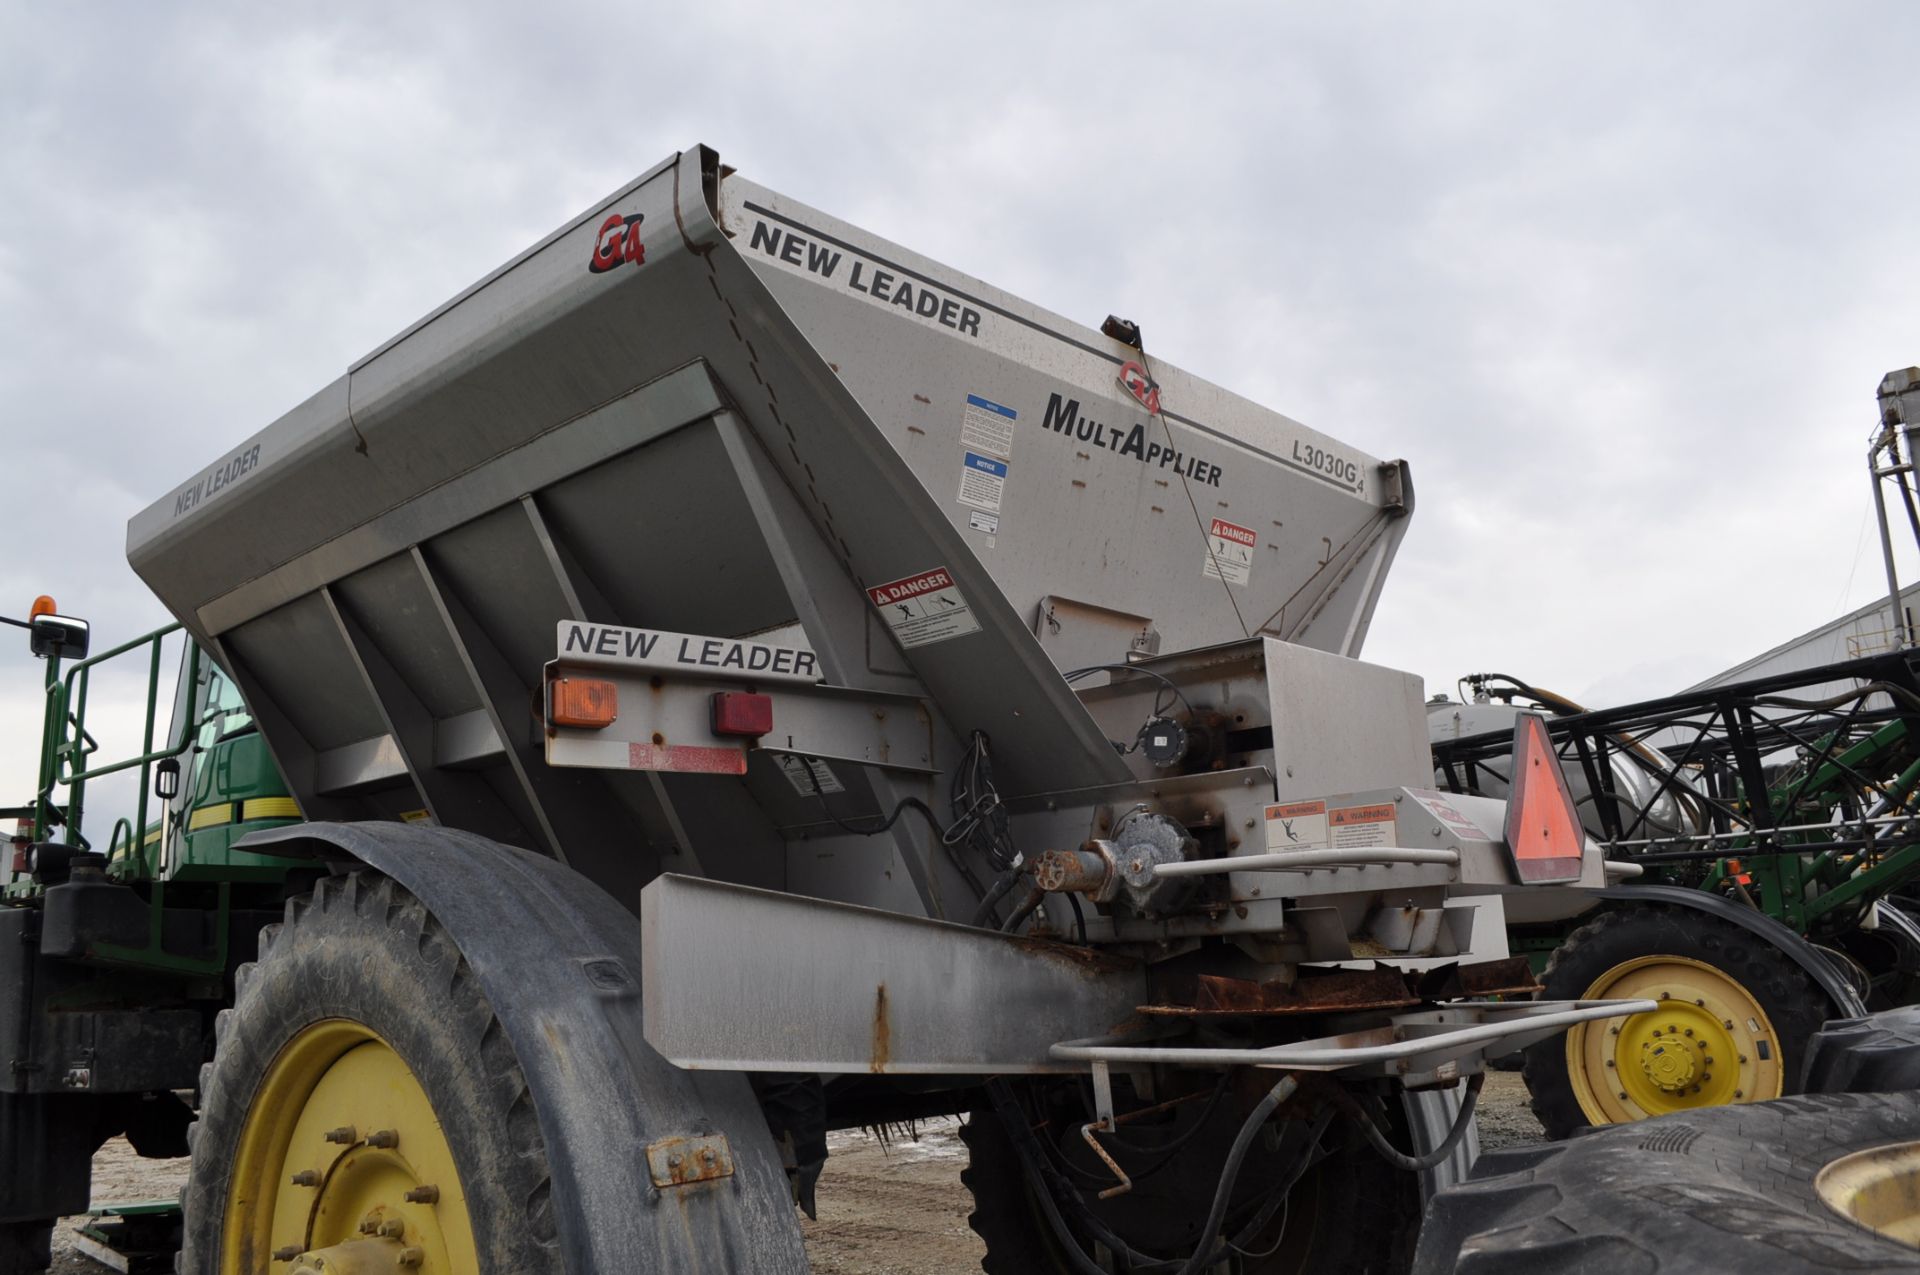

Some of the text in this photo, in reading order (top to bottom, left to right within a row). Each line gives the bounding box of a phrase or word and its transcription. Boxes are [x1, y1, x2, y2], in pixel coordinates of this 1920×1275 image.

[593, 213, 645, 271] G4
[750, 221, 981, 337] NEW LEADER
[173, 444, 260, 517] NEW LEADER
[1222, 525, 1254, 545] DANGER
[889, 573, 949, 599] DANGER
[565, 625, 816, 676] NEW LEADER
[1350, 809, 1390, 820] WARNING
